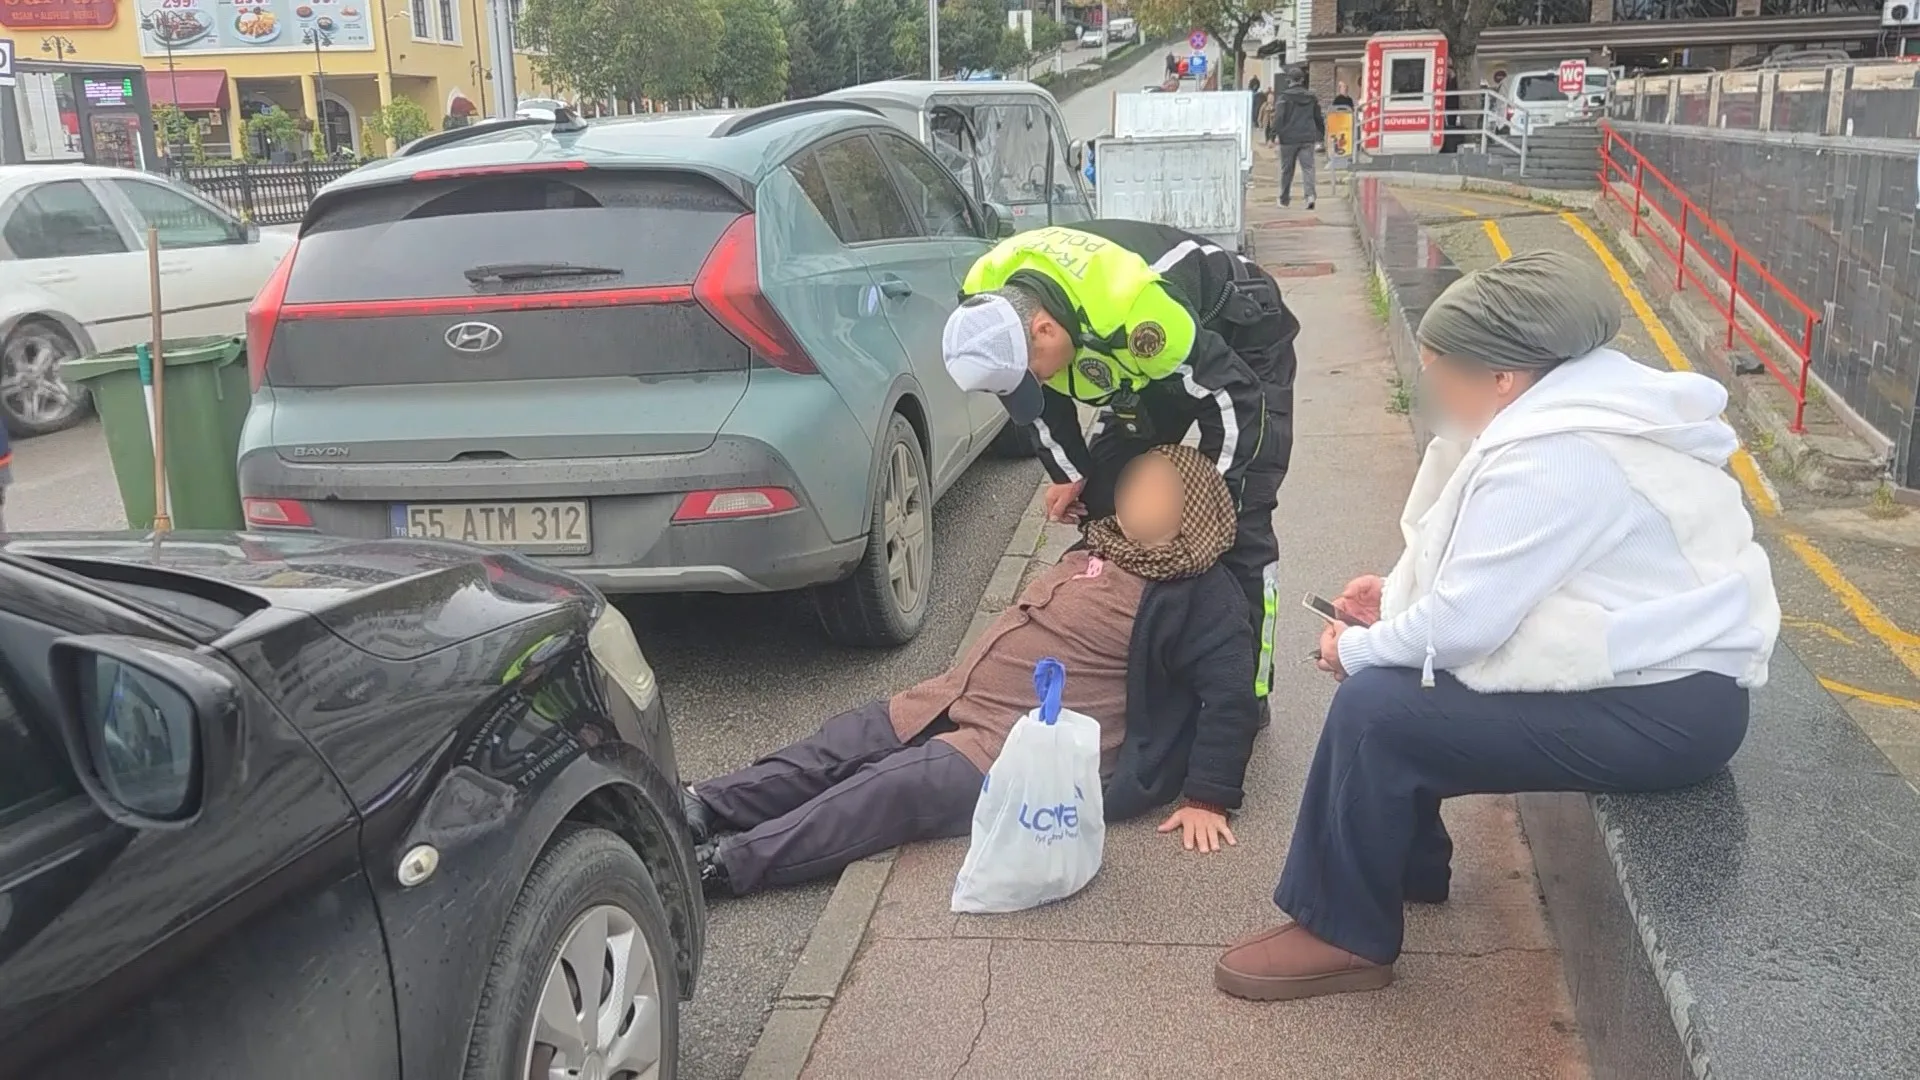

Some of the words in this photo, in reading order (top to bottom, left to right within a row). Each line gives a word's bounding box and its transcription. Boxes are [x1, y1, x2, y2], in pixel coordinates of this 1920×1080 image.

[1562, 67, 1583, 82] WC
[293, 447, 350, 456] BAYON
[410, 508, 444, 538] 55
[462, 506, 517, 541] ATM
[531, 506, 582, 540] 312
[395, 526, 408, 536] TR
